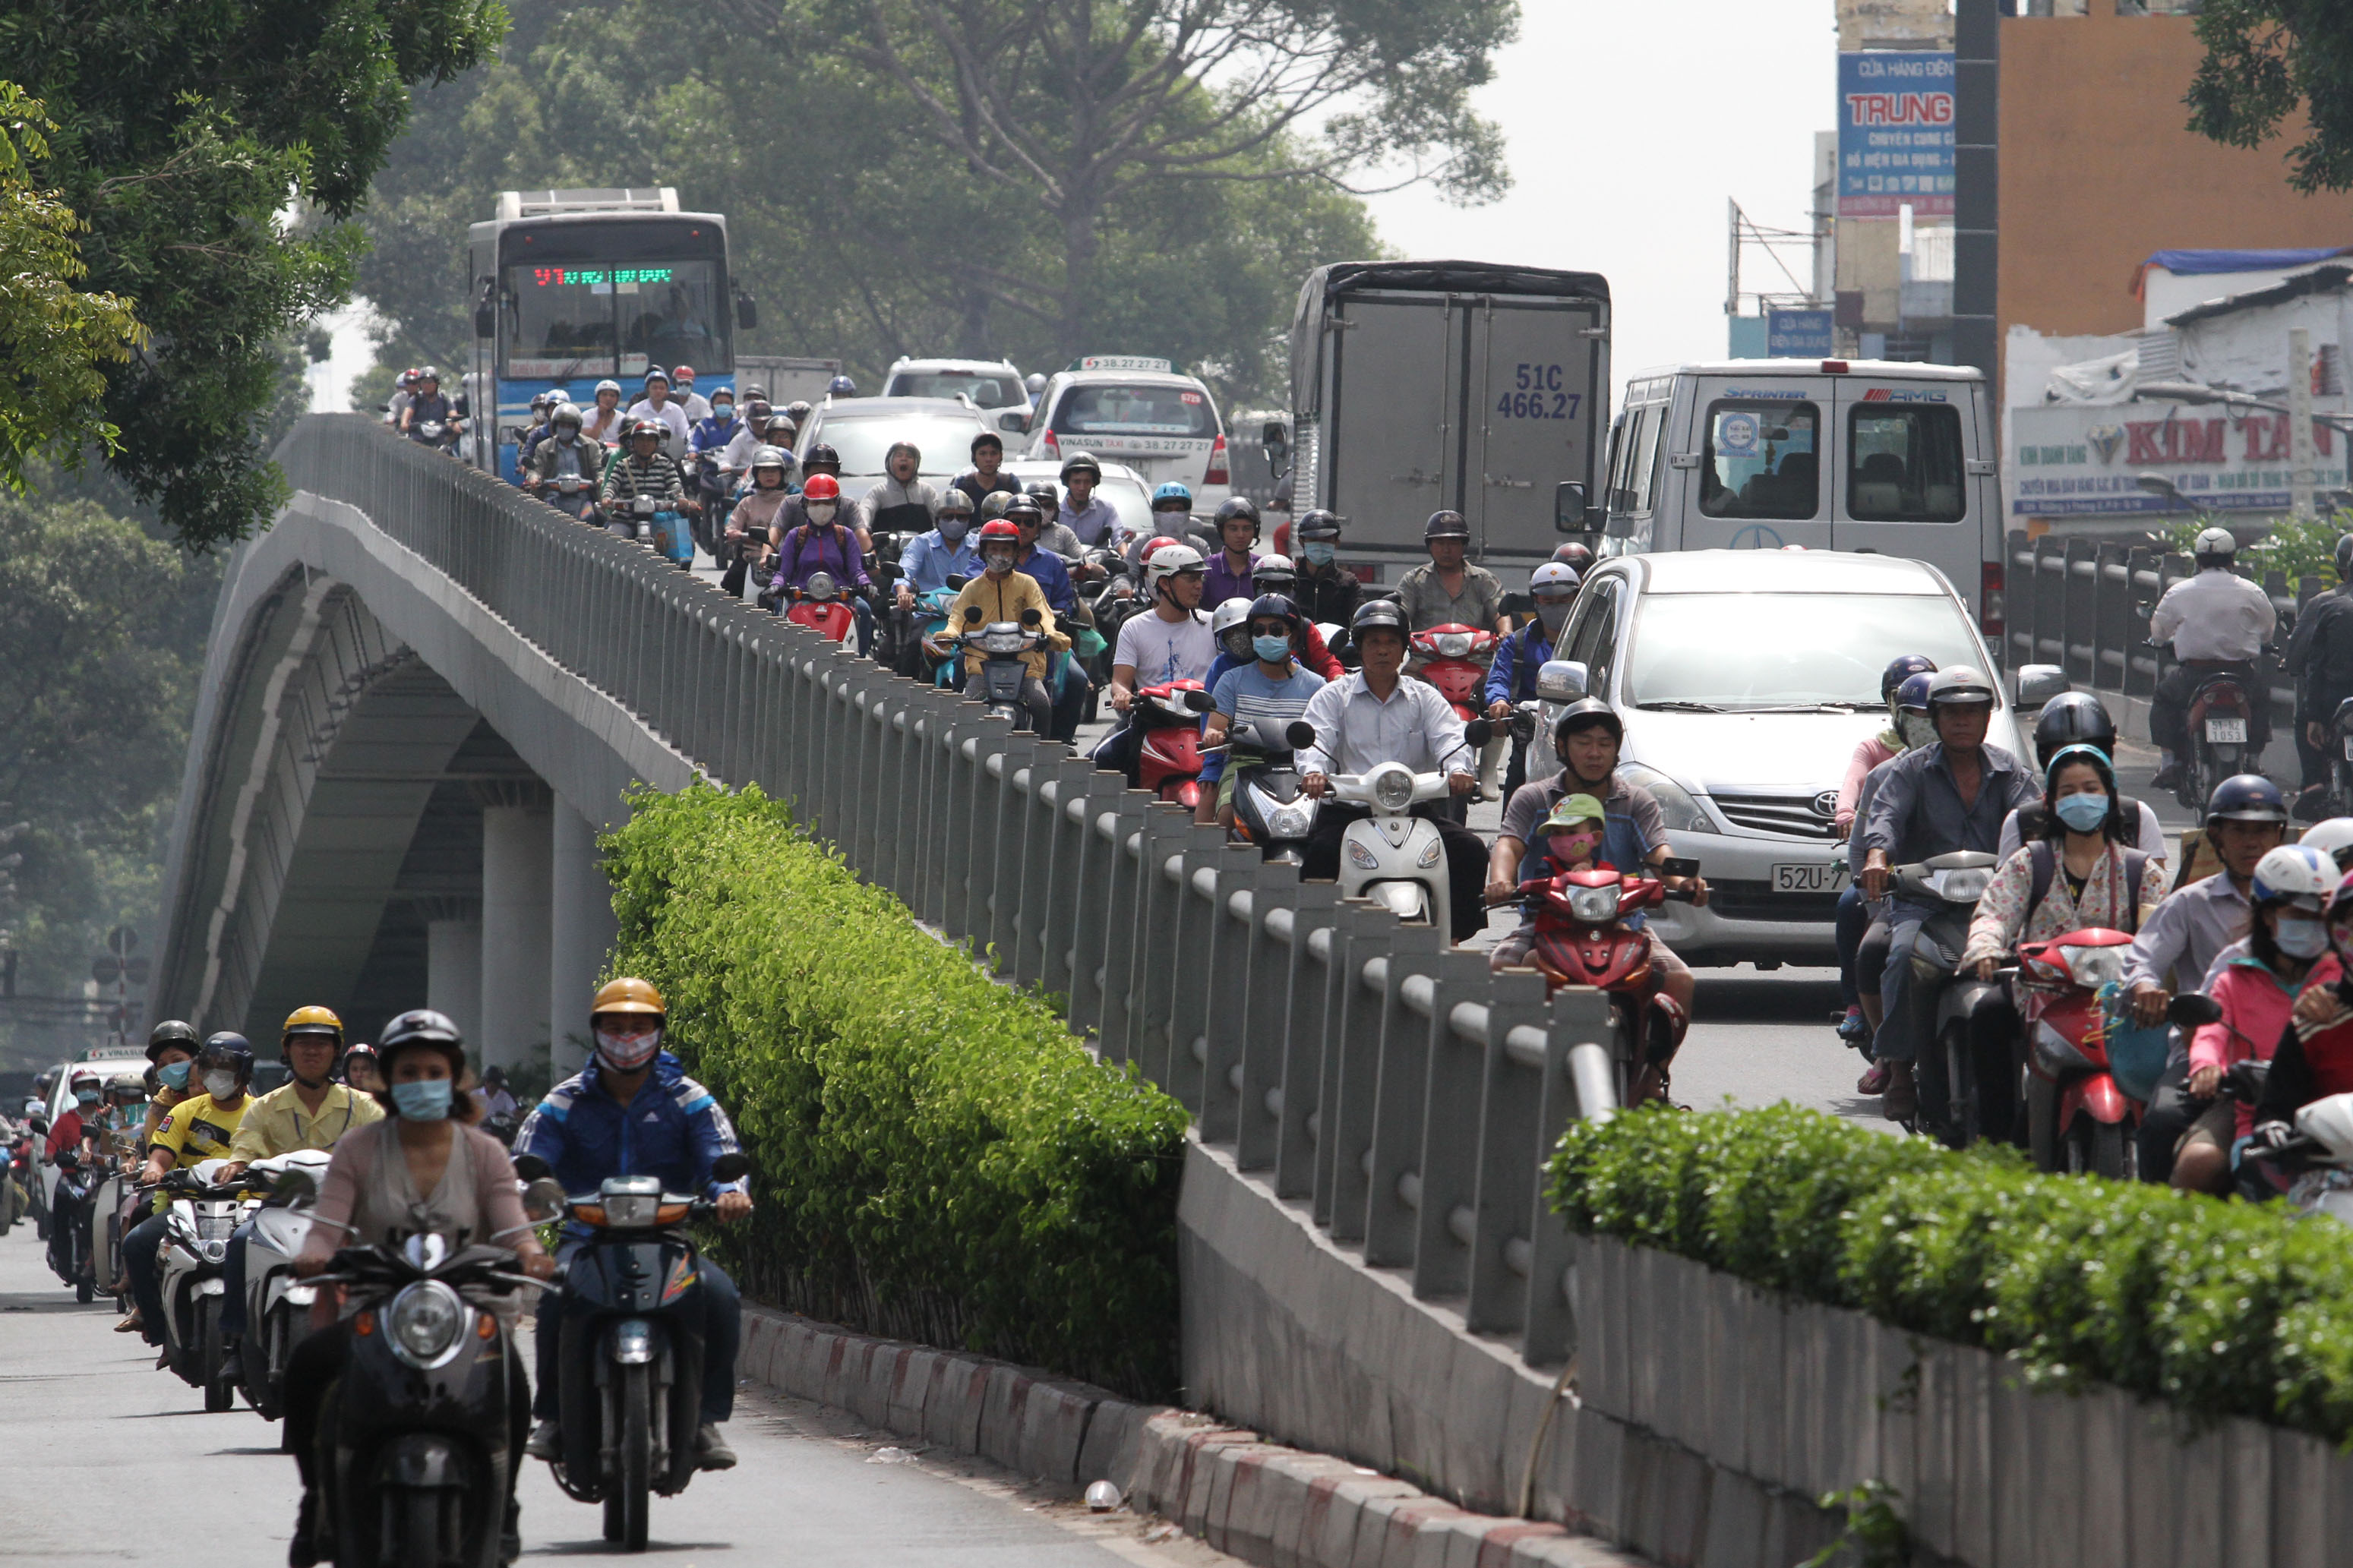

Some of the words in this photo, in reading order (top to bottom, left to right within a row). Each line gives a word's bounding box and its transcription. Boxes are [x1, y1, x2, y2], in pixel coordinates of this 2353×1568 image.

[1846, 92, 1953, 125] TRUNG
[1138, 360, 1150, 368] 27
[1154, 360, 1167, 369] 27
[1516, 363, 1562, 390] 51C
[1497, 393, 1581, 419] 466.27
[1888, 390, 1947, 402] AMG
[1060, 437, 1103, 446] VINASUN
[1180, 441, 1192, 450] 27
[1197, 442, 1209, 450] 27
[2124, 418, 2227, 464] KIM
